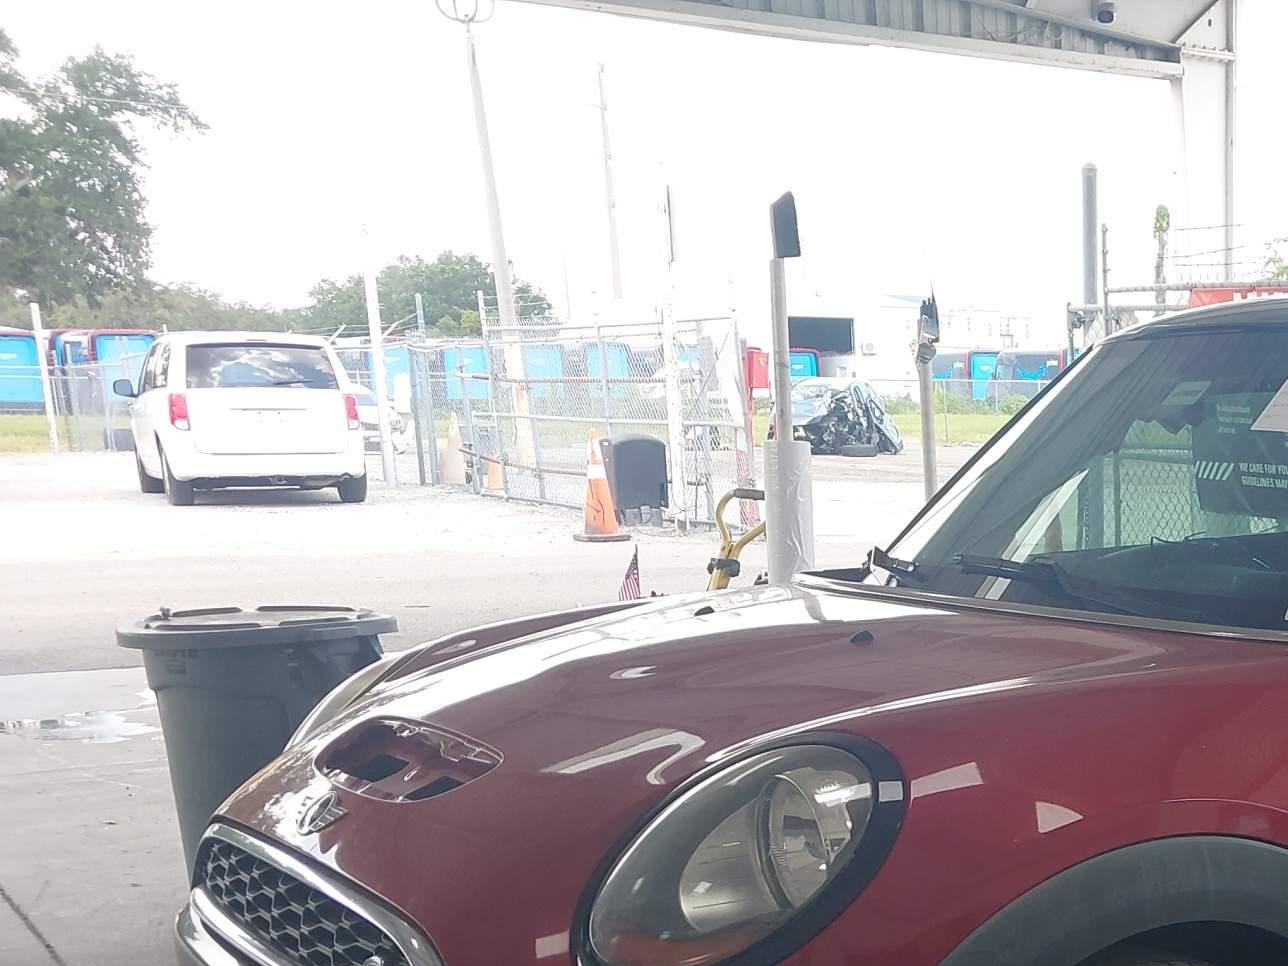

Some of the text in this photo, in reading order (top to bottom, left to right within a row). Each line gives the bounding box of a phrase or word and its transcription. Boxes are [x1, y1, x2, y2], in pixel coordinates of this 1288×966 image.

[1239, 462, 1249, 473] WE
[1249, 463, 1264, 474] CARE
[1264, 463, 1277, 475] FOR
[1241, 476, 1274, 488] GUIDELINES
[1275, 478, 1288, 489] MAY
